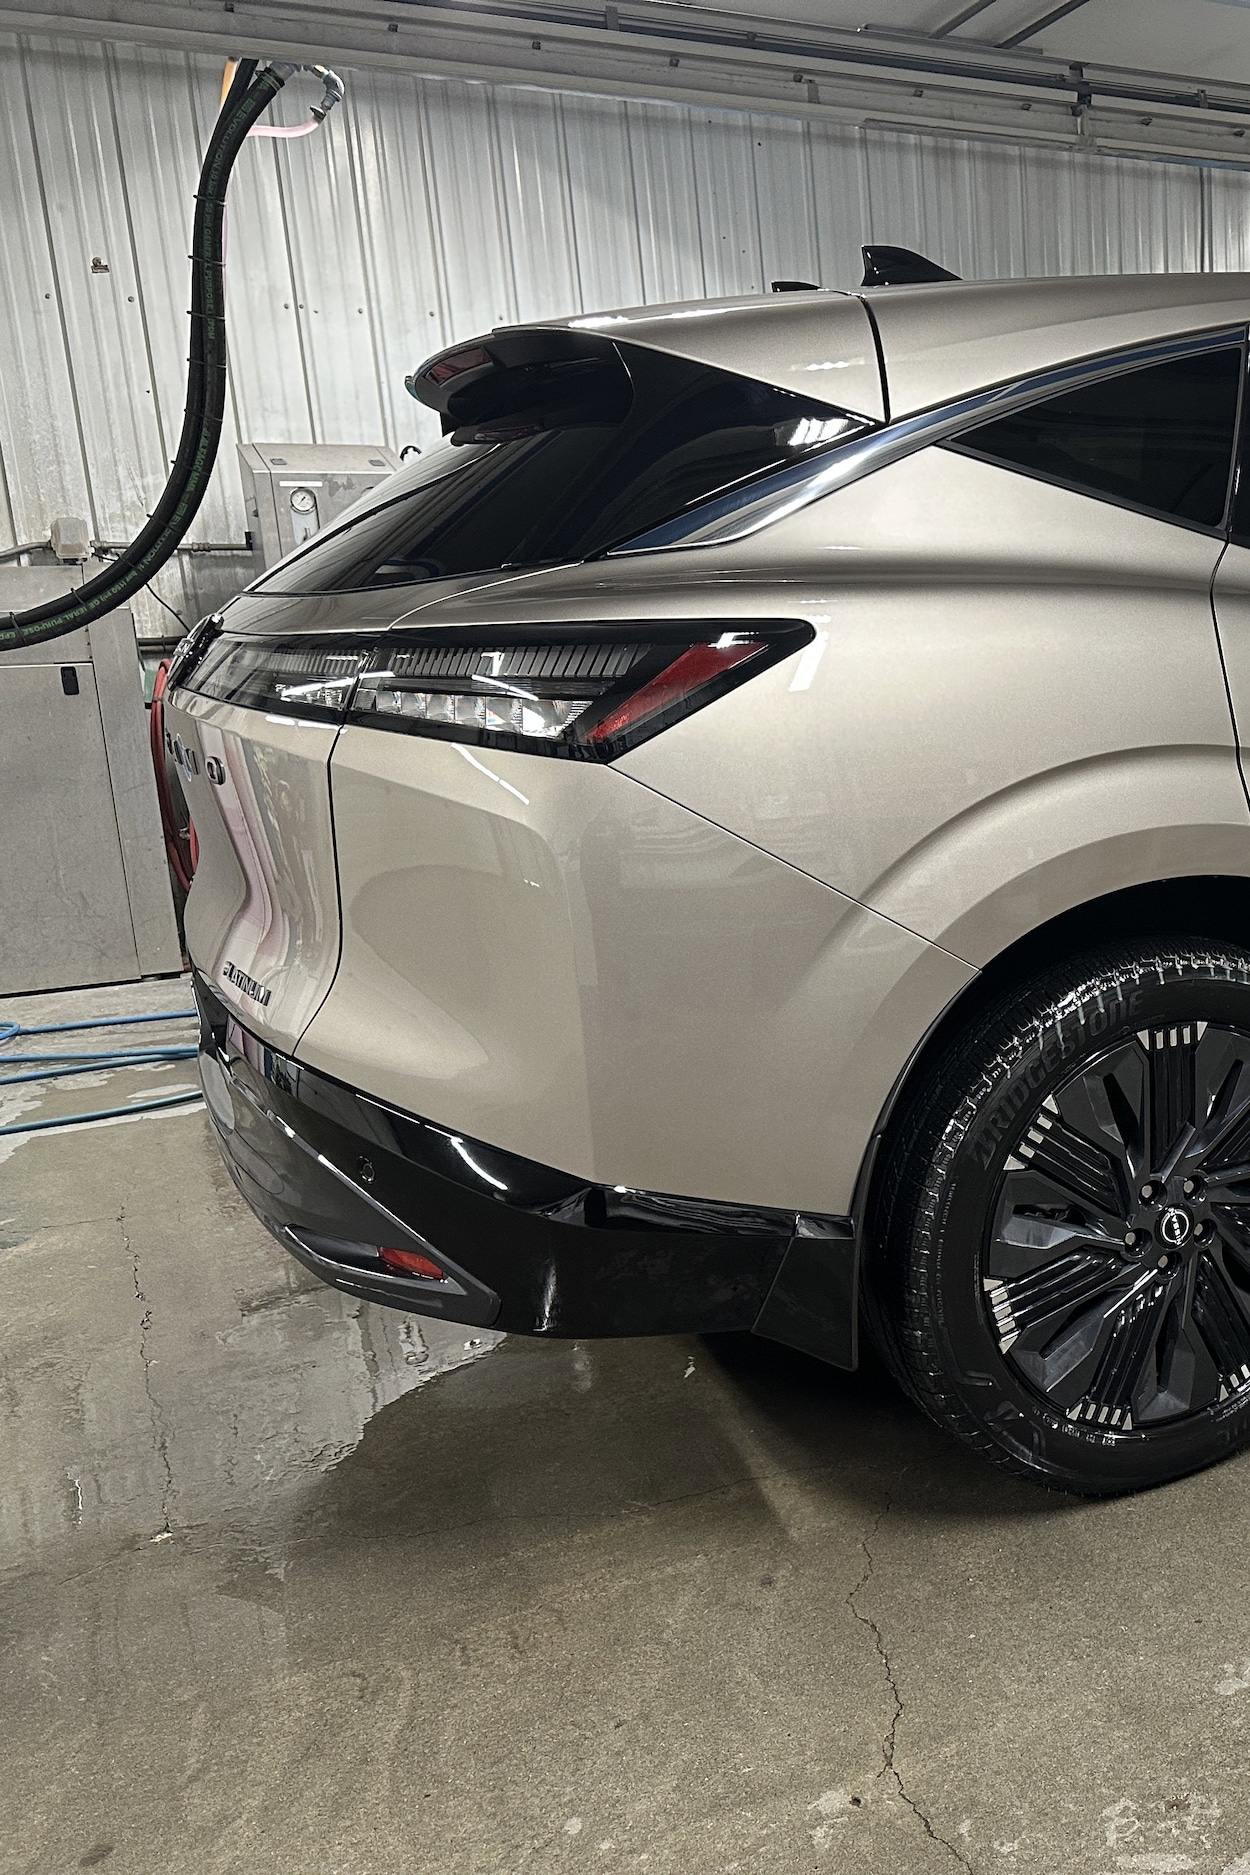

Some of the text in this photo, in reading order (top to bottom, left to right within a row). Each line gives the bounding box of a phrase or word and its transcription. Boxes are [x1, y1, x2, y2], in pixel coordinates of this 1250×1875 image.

[211, 111, 247, 170] EVOLUTION
[203, 270, 214, 311] PURPOSE
[22, 619, 63, 636] PURPOSE
[222, 960, 272, 1007] PLATINUM
[1166, 1206, 1183, 1246] NISSAN
